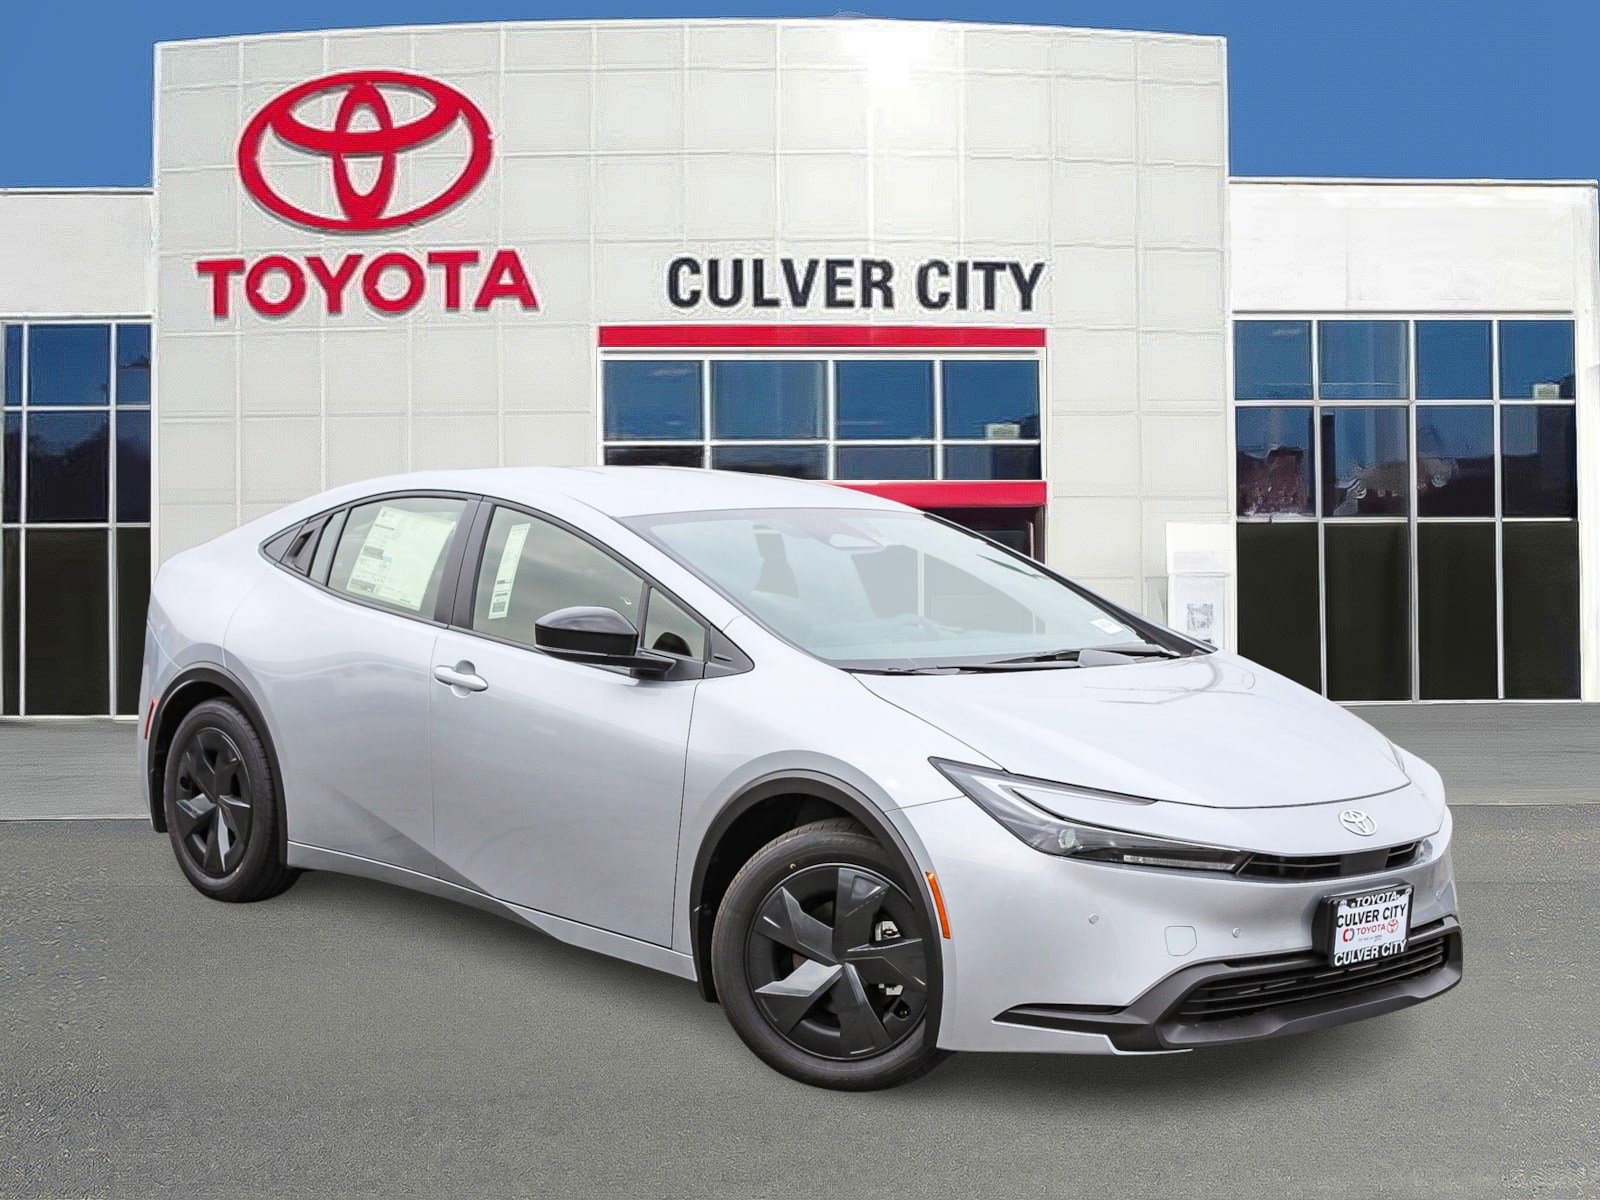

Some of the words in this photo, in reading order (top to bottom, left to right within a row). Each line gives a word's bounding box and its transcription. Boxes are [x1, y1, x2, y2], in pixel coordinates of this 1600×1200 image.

[197, 249, 539, 318] TOYOTA
[668, 257, 894, 309] CULVER
[916, 259, 1046, 311] CITY
[1356, 891, 1397, 907] TOYOTA
[1336, 909, 1379, 928] CULVER
[1382, 903, 1407, 920] CITY
[1356, 924, 1386, 935] TOYOTA
[1334, 945, 1379, 967] CULVER
[1381, 939, 1408, 957] CITY
